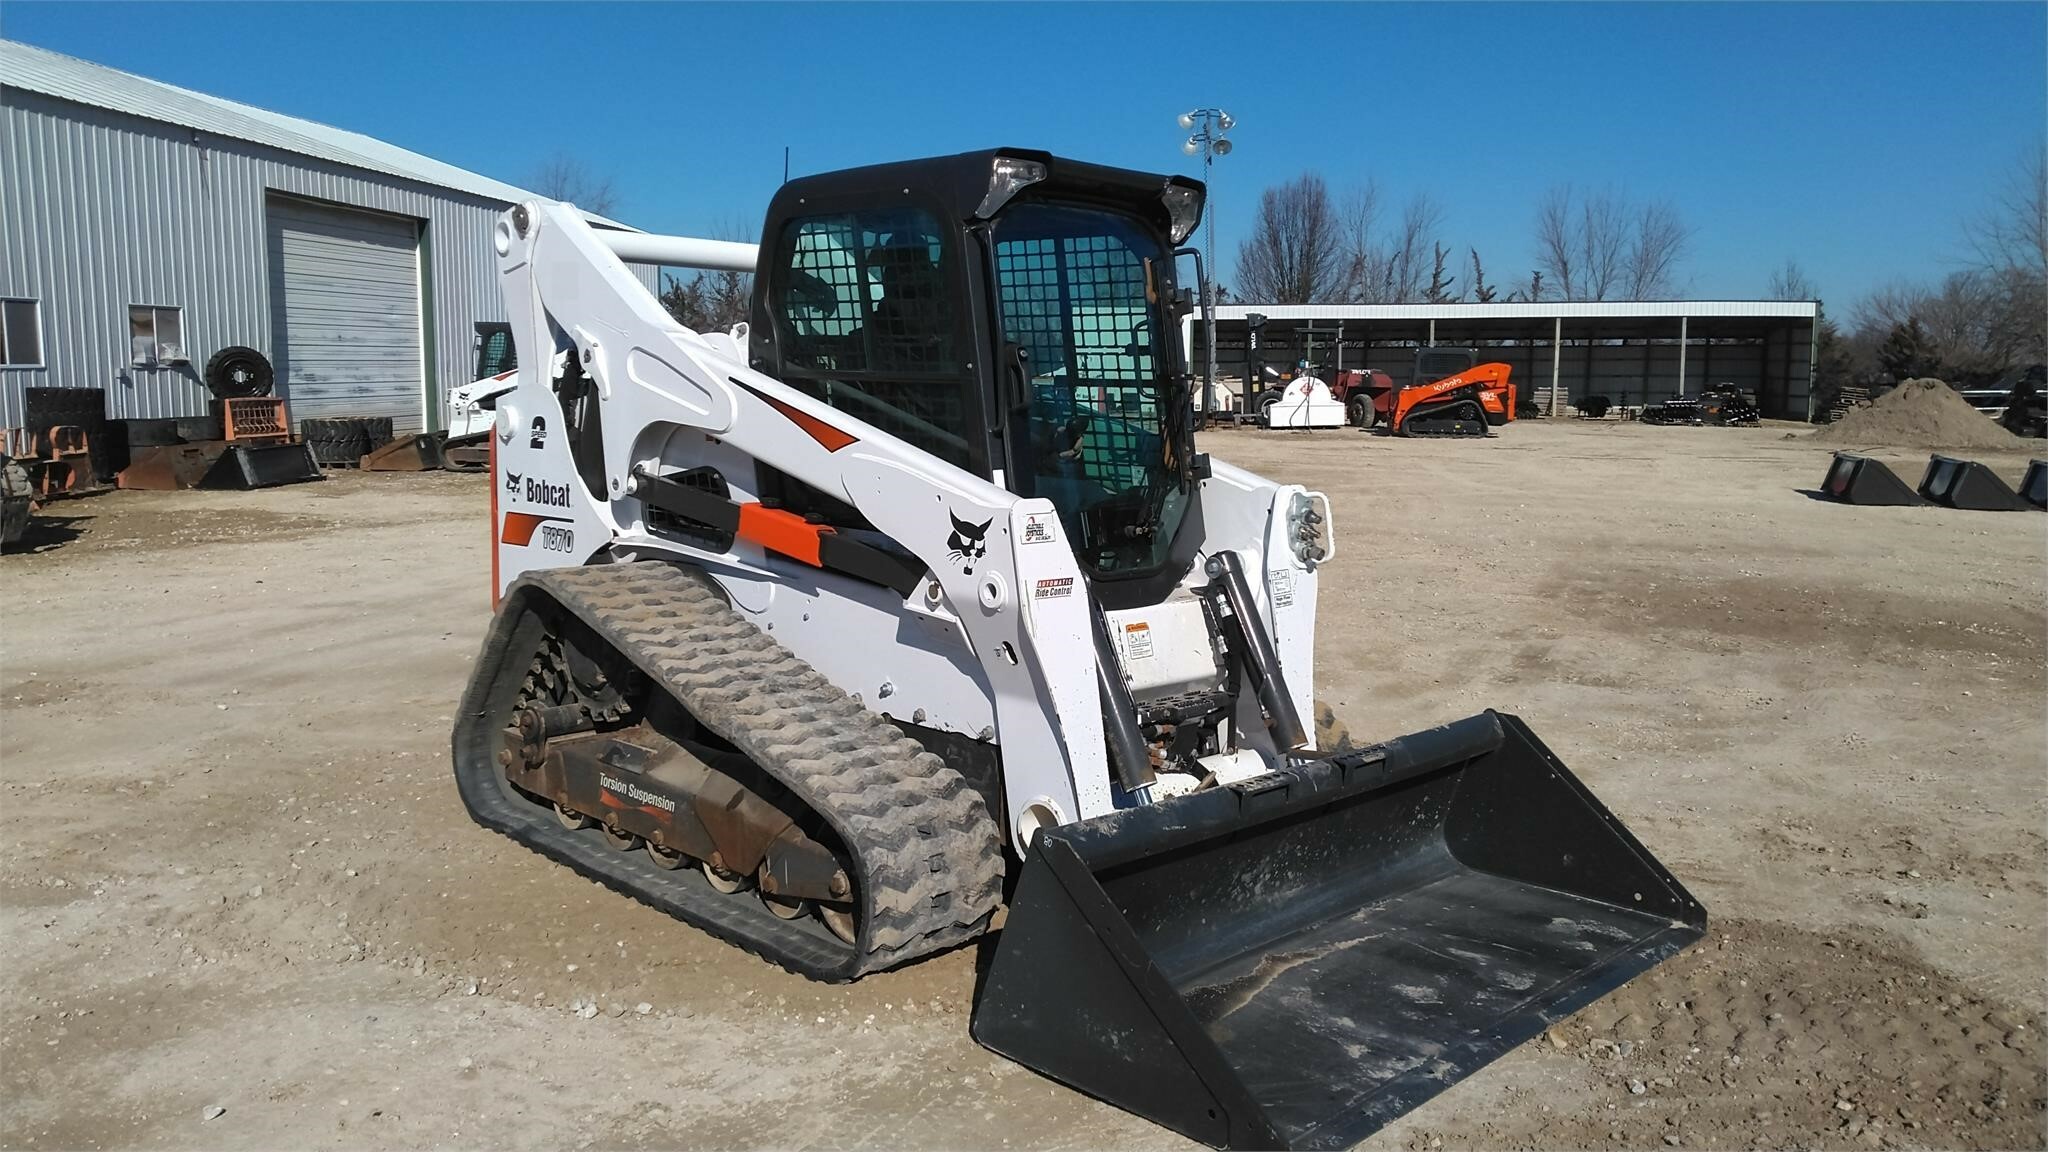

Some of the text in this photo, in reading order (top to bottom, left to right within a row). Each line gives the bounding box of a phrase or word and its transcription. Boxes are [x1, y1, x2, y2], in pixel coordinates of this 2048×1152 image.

[1433, 378, 1462, 391] Kubota
[529, 415, 546, 450] 2
[526, 477, 571, 508] Bobcat
[542, 525, 575, 553] T870
[1035, 586, 1073, 598] Ride Control
[1038, 578, 1073, 588] AUTOMATIC
[600, 772, 675, 812] Torsion Suspension
